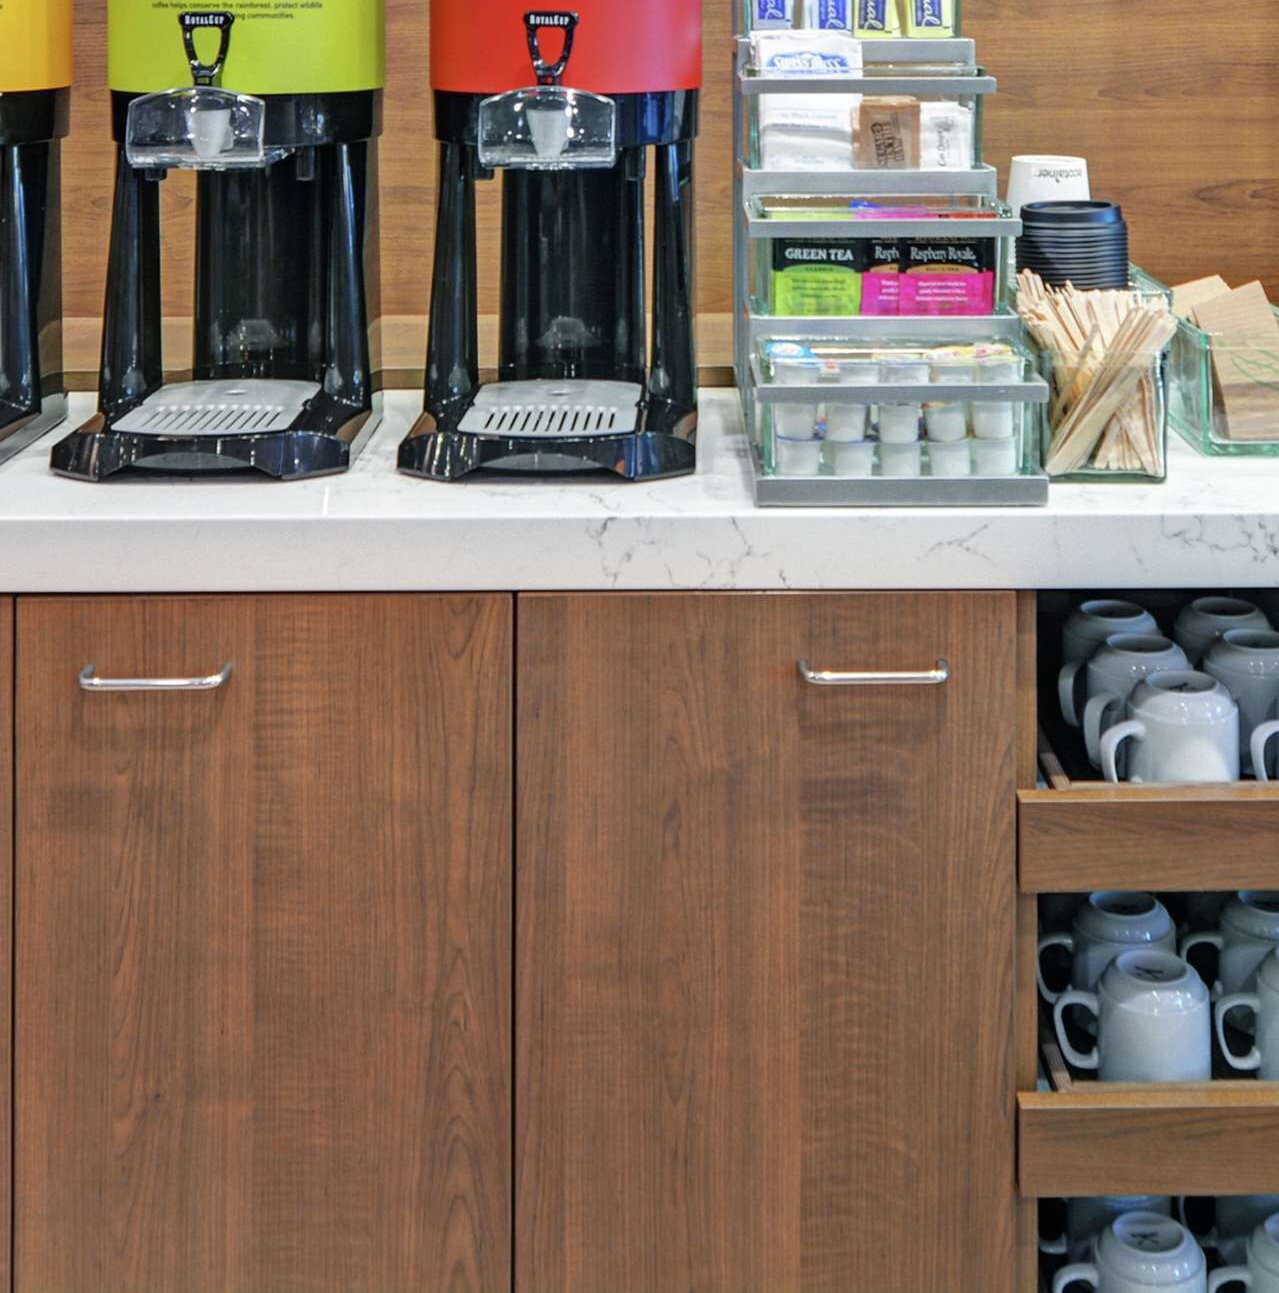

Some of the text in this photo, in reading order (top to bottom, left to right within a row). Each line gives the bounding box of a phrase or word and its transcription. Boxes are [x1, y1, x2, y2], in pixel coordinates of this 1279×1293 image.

[170, 2, 187, 10] helps
[188, 2, 220, 10] conserve
[221, 2, 234, 10] the
[274, 2, 298, 10] protect
[784, 247, 854, 261] GREEN TEA
